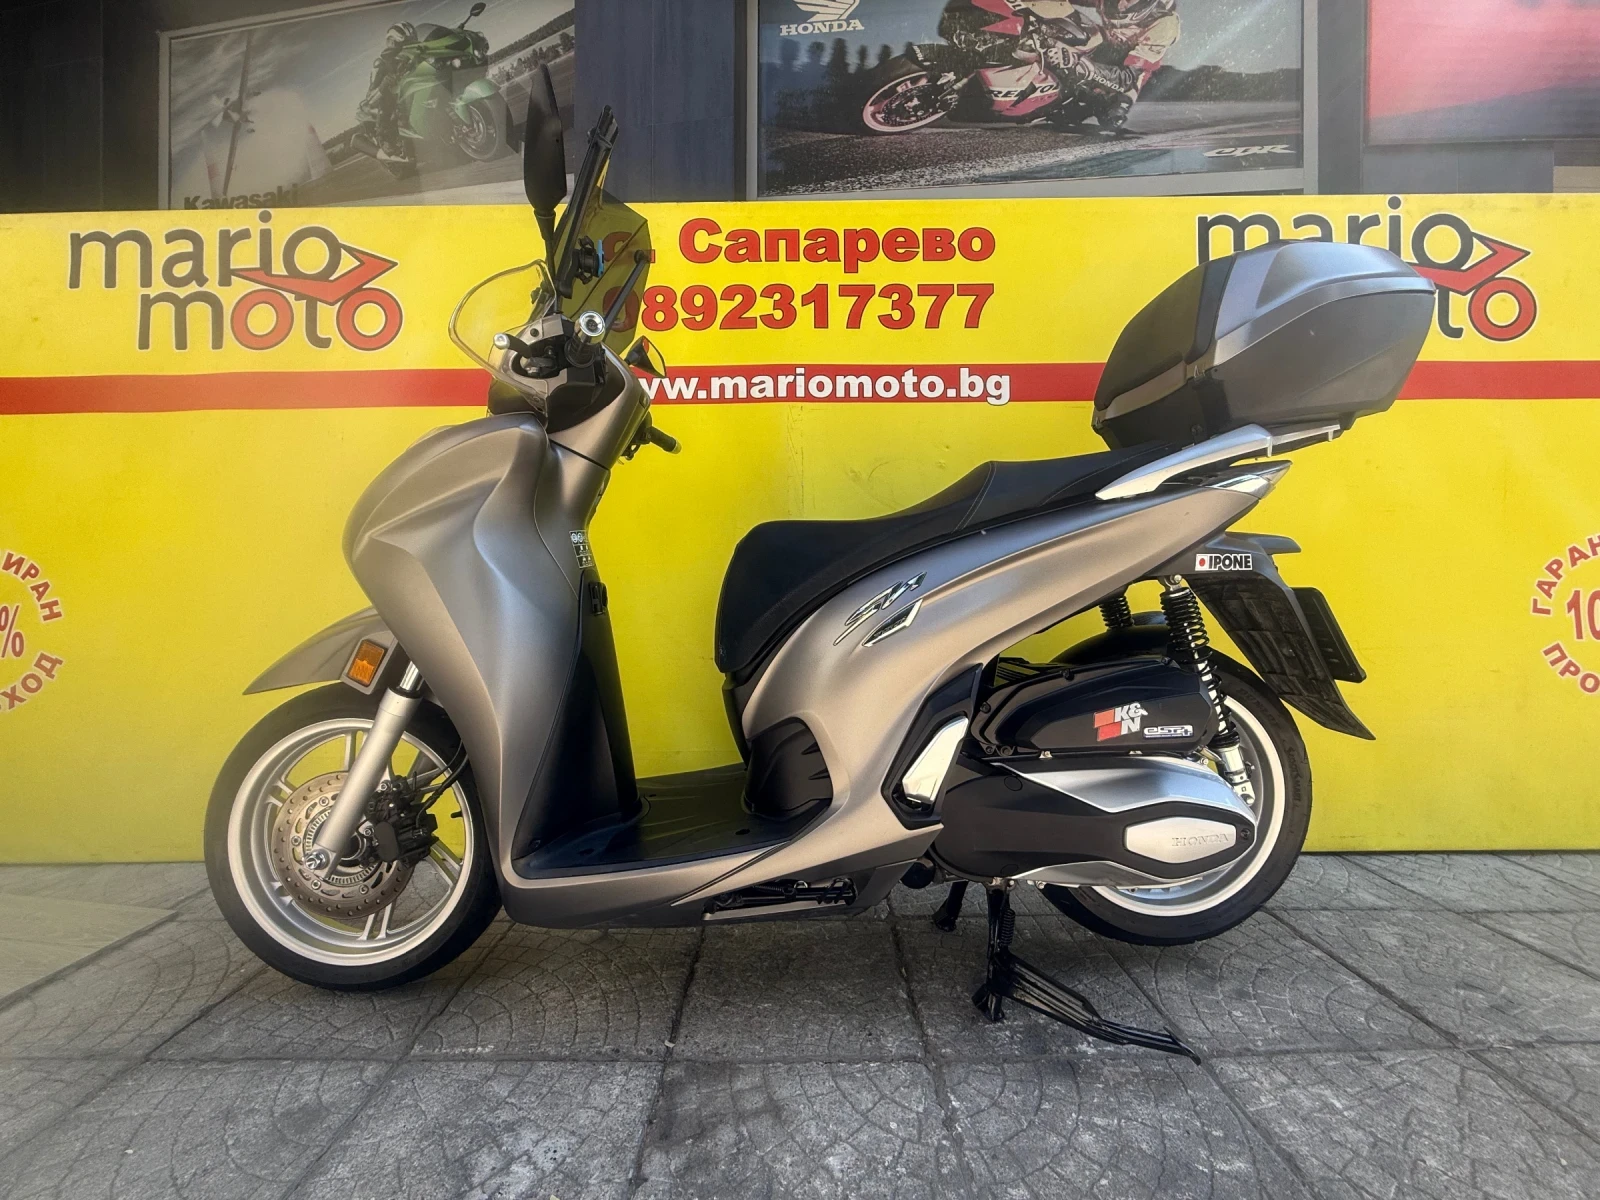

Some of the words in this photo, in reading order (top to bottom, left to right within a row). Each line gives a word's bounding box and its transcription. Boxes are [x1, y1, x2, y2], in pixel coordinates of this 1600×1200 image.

[780, 19, 865, 36] HONDA
[184, 183, 299, 210] Kawasaki
[69, 210, 342, 289] mario
[679, 217, 996, 274] Сапарево
[138, 287, 404, 352] moto
[602, 283, 995, 333] 0892317377
[1208, 555, 1252, 570] IPONE
[0, 652, 64, 710] ХОД
[1171, 833, 1230, 847] HONDA
